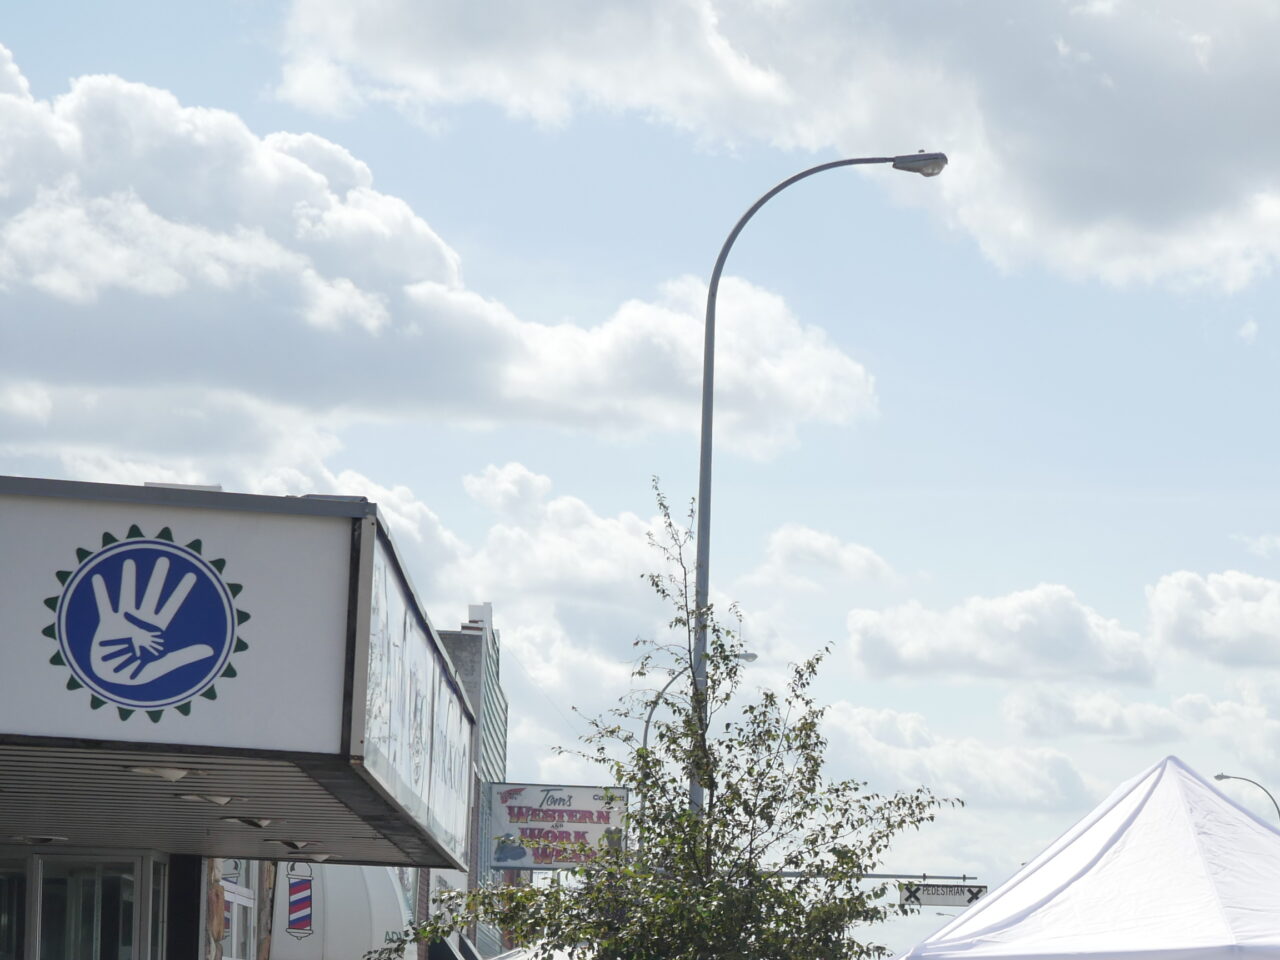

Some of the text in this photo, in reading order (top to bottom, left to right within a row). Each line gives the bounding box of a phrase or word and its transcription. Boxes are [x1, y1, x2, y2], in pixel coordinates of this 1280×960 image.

[540, 788, 573, 808] Tom's
[507, 805, 611, 825] WESTERN
[518, 827, 589, 845] WORK
[922, 886, 965, 897] PEDESTRIAN
